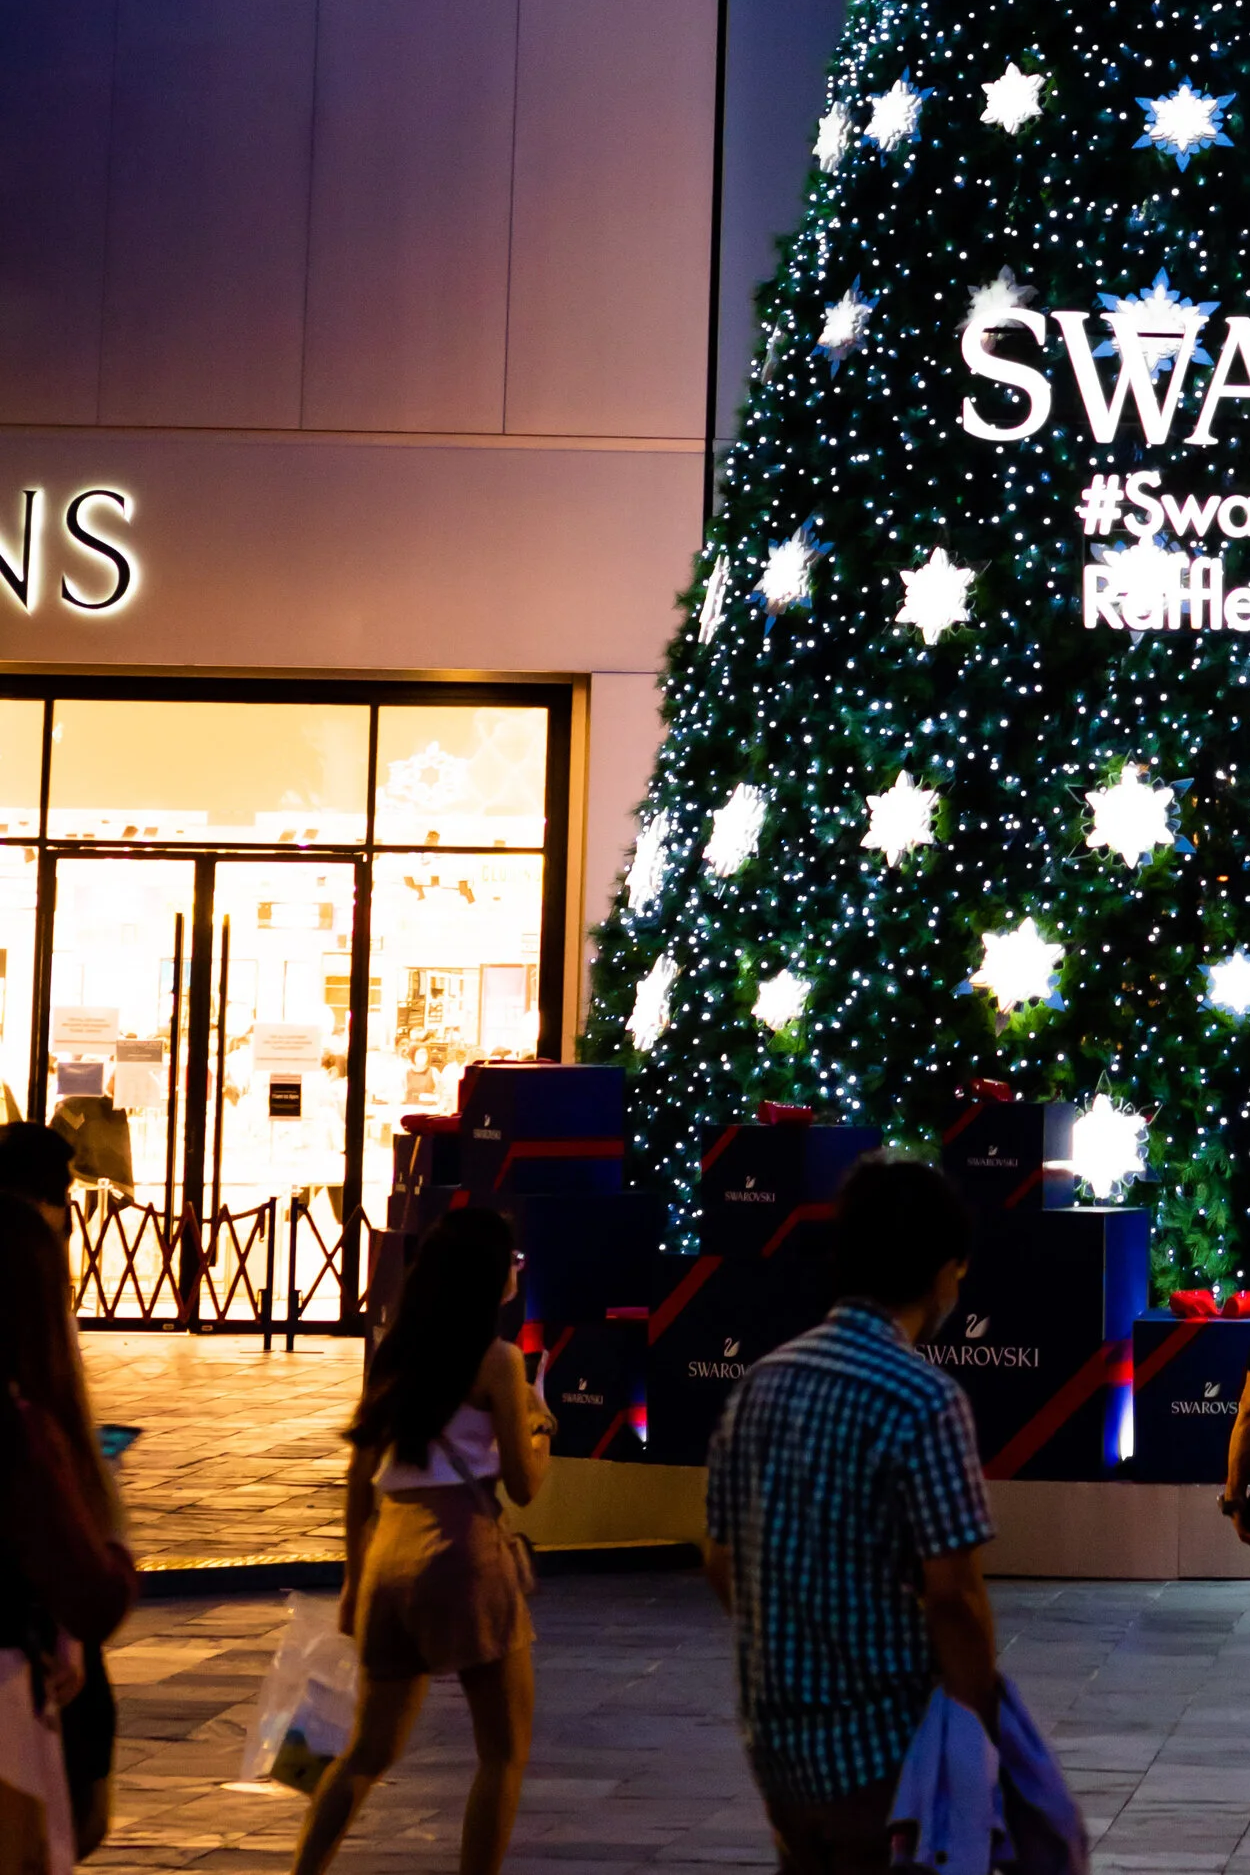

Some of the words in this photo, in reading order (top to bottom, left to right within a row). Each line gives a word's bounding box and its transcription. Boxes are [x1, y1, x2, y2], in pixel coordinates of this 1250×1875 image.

[913, 1343, 1039, 1368] SWAROVSKI
[688, 1360, 753, 1379] SWAROV
[1171, 1400, 1238, 1415] SWAROVS
